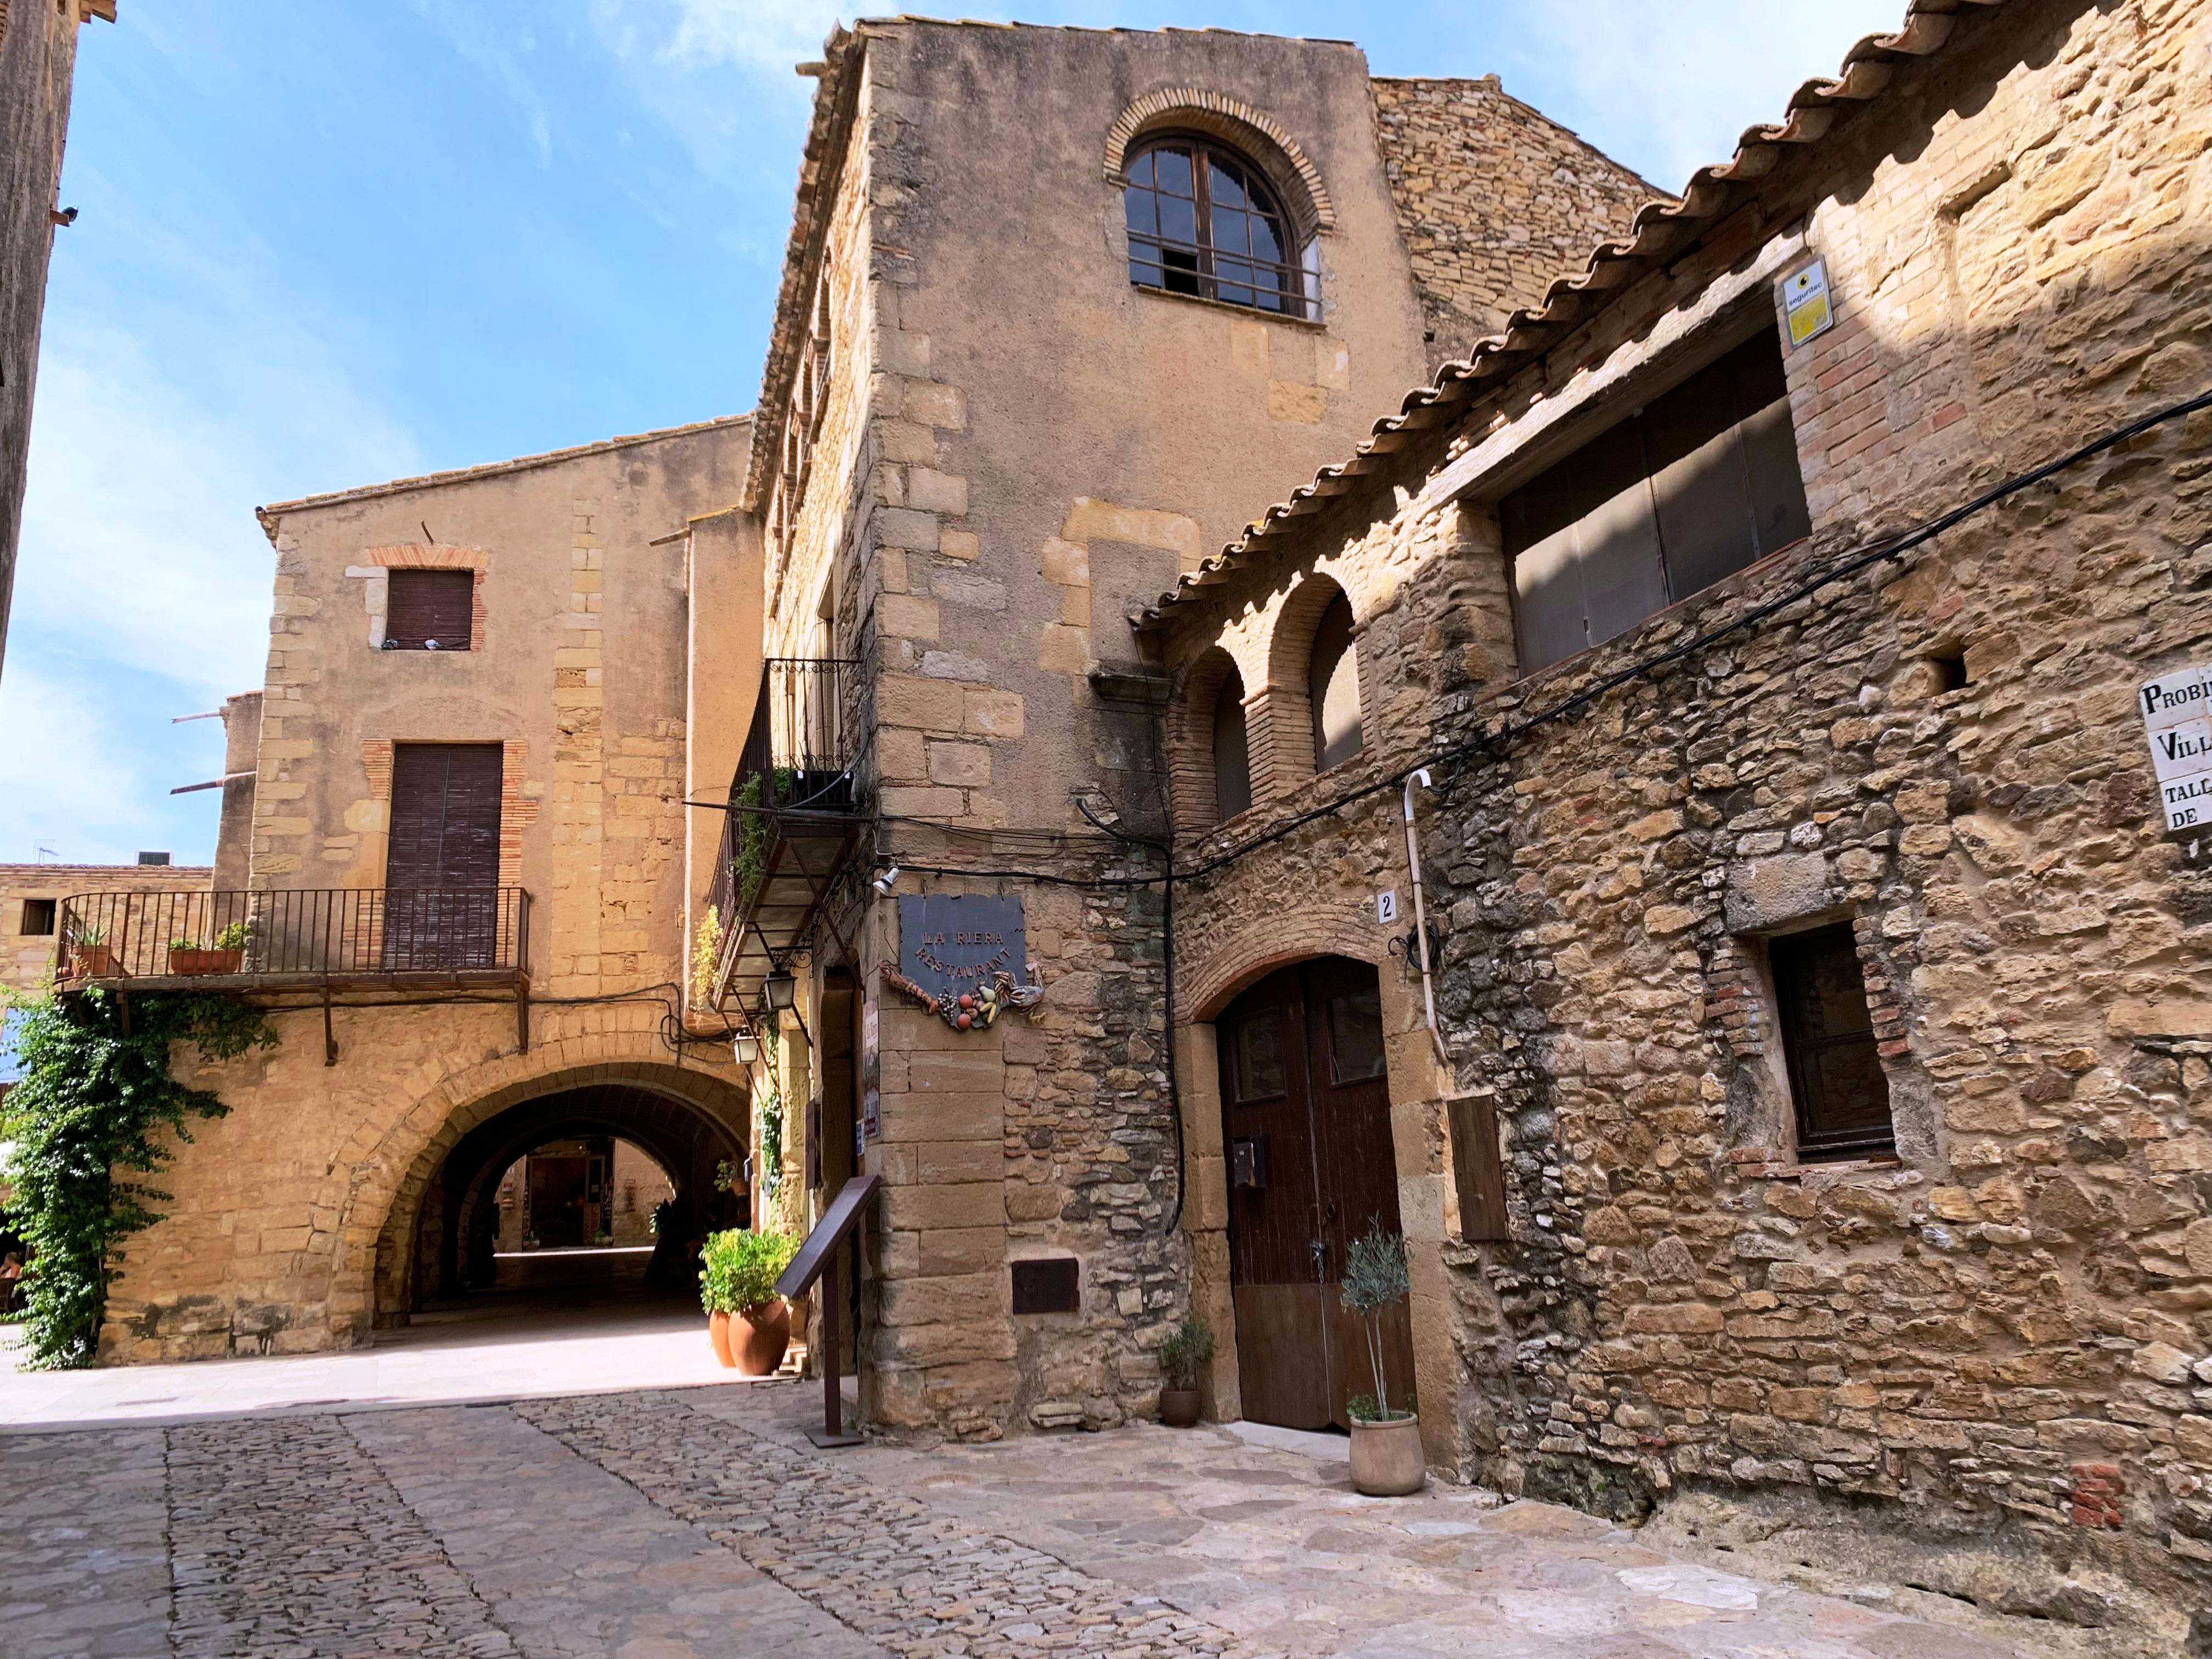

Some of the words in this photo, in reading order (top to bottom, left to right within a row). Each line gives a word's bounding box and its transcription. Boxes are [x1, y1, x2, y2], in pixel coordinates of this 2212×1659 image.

[1789, 281, 1822, 307] seguritec
[2172, 808, 2197, 828] DE
[1383, 895, 1392, 917] 2
[923, 932, 944, 945] LA
[956, 932, 1004, 945] RIERA
[915, 946, 1012, 978] RESTAURANT
